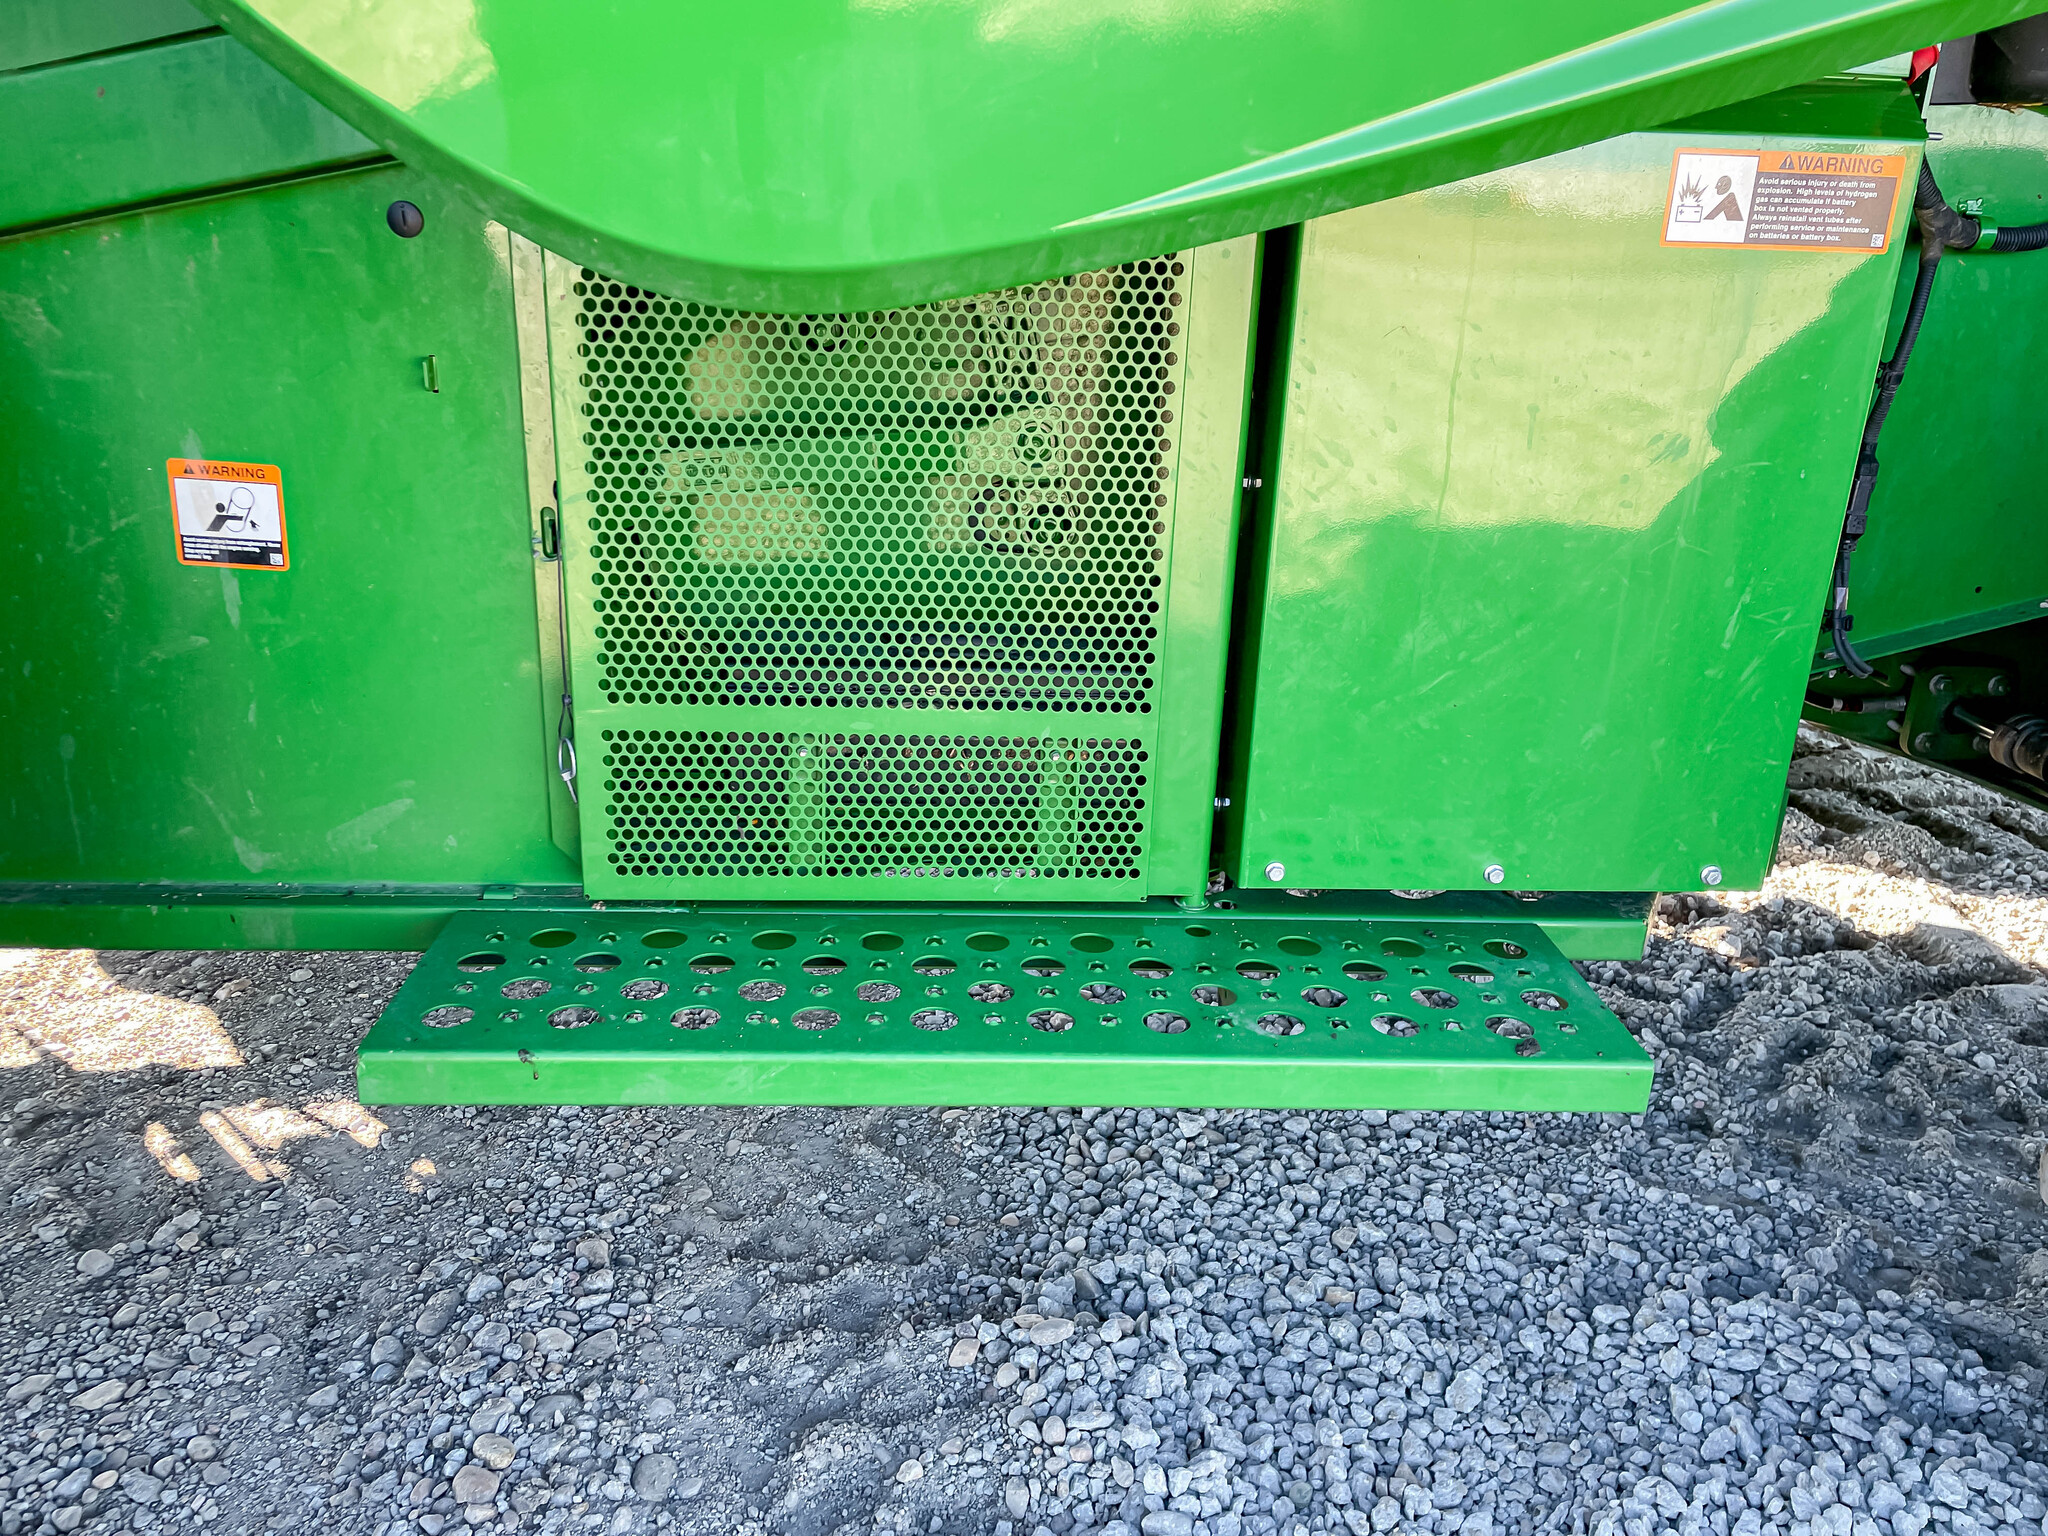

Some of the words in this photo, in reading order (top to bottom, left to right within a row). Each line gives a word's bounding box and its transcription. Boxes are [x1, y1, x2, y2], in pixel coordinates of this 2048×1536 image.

[1798, 155, 1883, 173] WARNING
[1759, 177, 1779, 185] Avoid
[1796, 188, 1813, 196] High
[1832, 199, 1856, 207] battery
[1801, 234, 1825, 242] battery
[198, 464, 266, 478] WARNING
